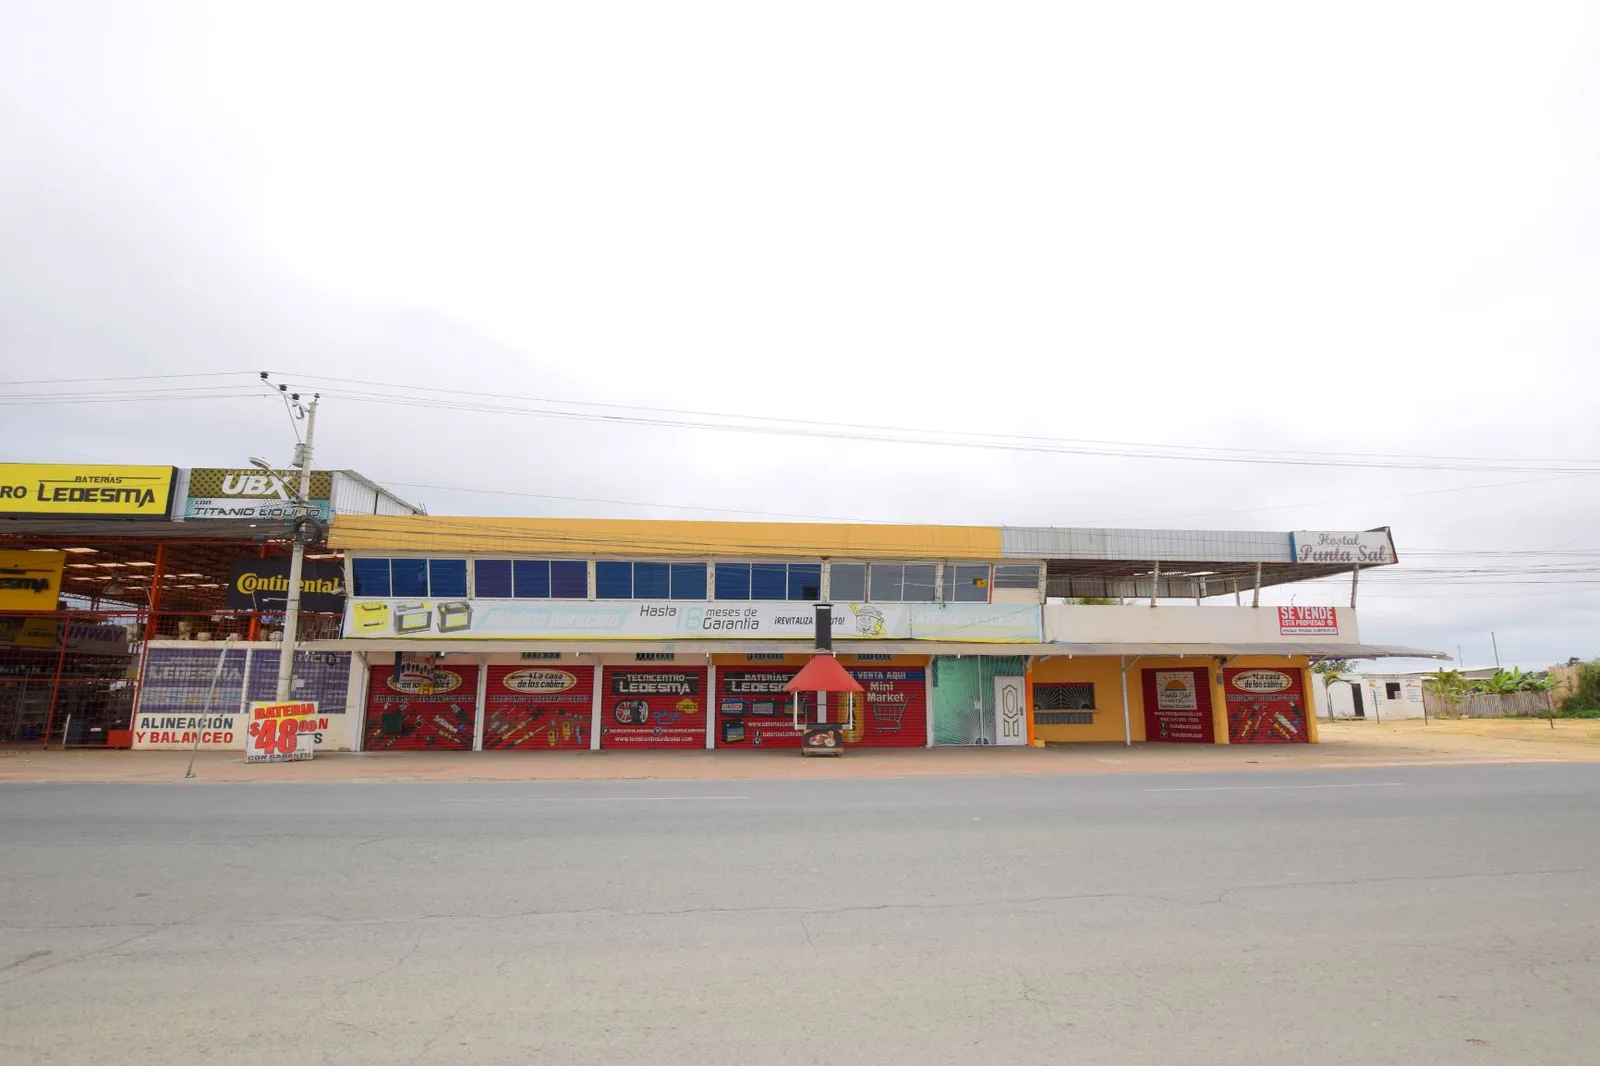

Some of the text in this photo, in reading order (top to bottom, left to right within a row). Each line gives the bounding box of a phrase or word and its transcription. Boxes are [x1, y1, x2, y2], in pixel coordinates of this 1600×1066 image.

[75, 473, 122, 484] BATERÍAS
[222, 475, 293, 501] UBX
[37, 482, 155, 509] LEDESMA
[195, 508, 320, 517] TITANIO LIQUIO
[1317, 533, 1361, 546] Hostal
[1299, 545, 1388, 562] Punta Sal
[640, 605, 677, 618] Hasta
[706, 607, 758, 617] meses de
[1281, 606, 1334, 619] SE VENDE
[676, 606, 704, 631] 18
[829, 616, 846, 626] UTO!
[626, 674, 685, 682] TECNICENTRO
[745, 672, 788, 682] BATERÍAS
[857, 671, 884, 680] VENTA
[886, 671, 906, 680] AQUI
[517, 679, 566, 689] de los cables
[619, 680, 691, 695] LEDESMA
[731, 681, 788, 692] LEDES
[870, 681, 894, 691] Mini
[1263, 680, 1283, 689] cables
[867, 692, 905, 703] Market
[140, 714, 233, 730] ALINEACIÓN
[135, 731, 233, 744] Y BALANCEO
